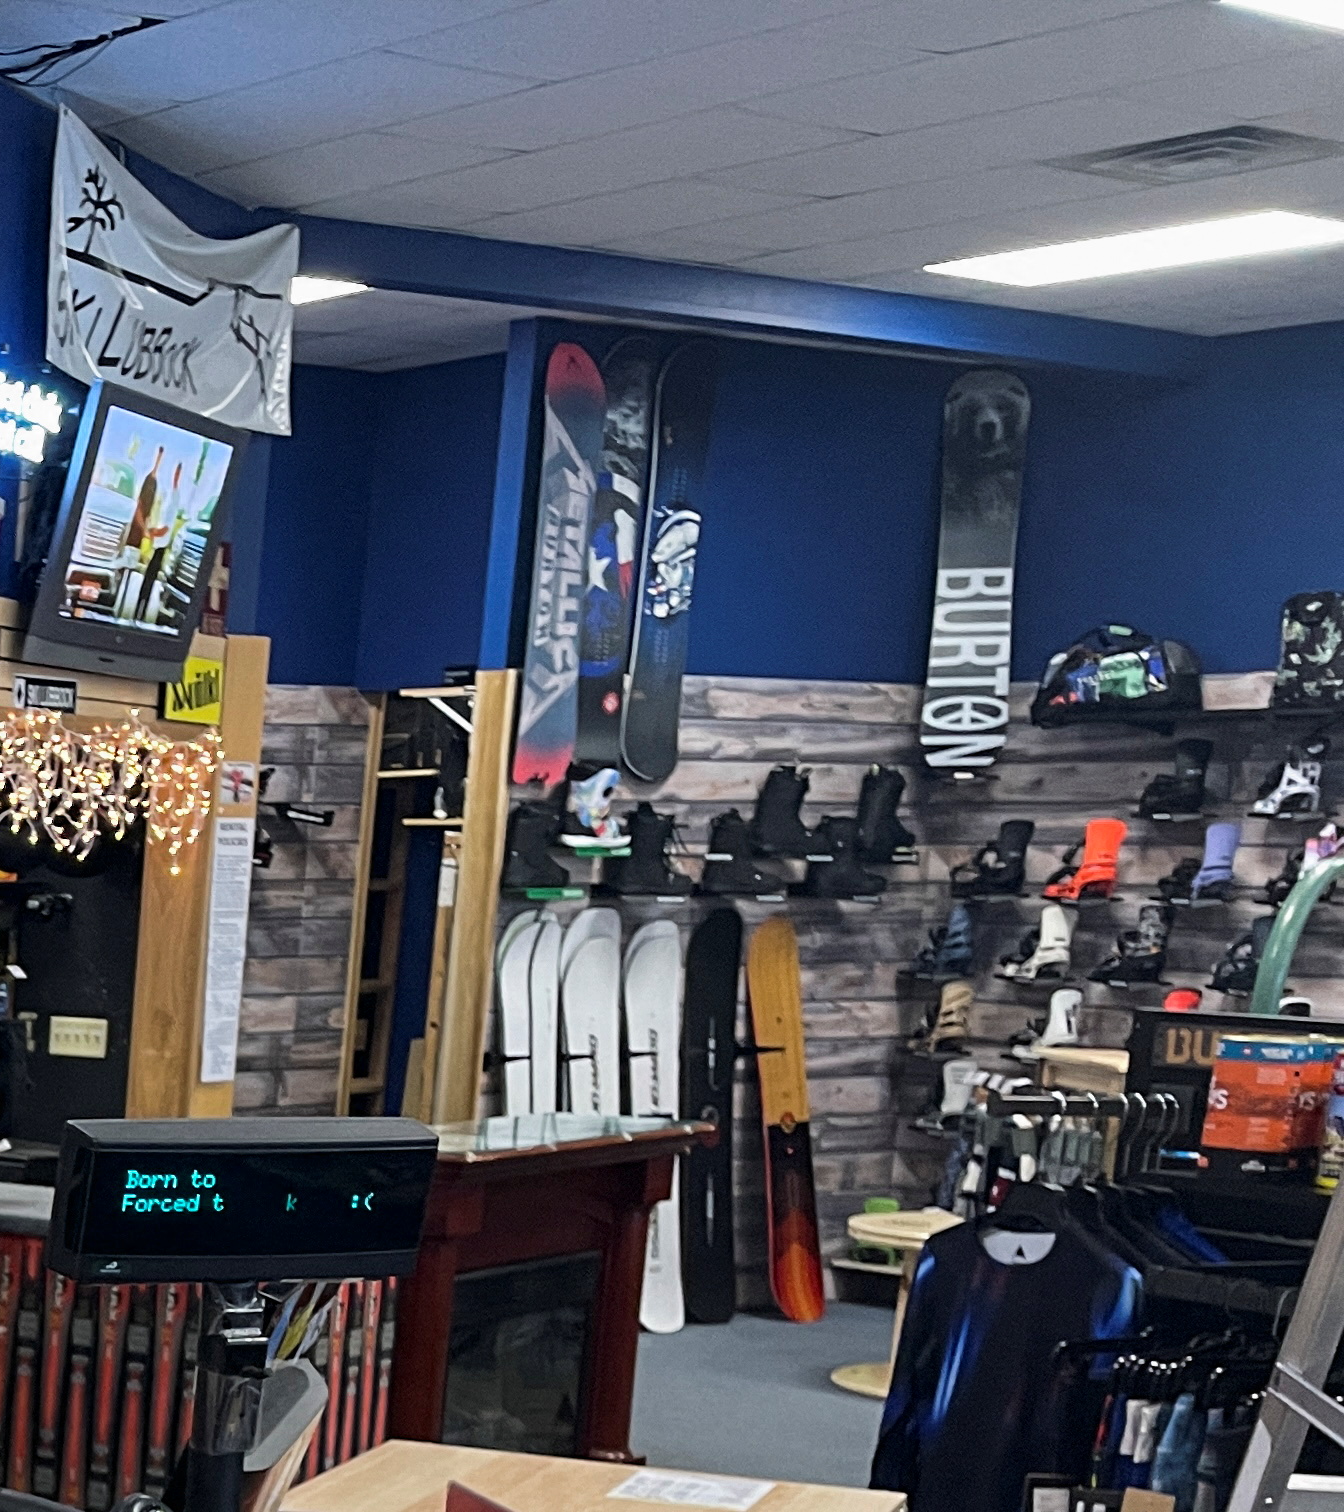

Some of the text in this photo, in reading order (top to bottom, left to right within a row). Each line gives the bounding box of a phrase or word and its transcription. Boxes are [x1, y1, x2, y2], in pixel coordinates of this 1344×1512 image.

[125, 1169, 217, 1189] Born to
[121, 1193, 201, 1213] Forced
